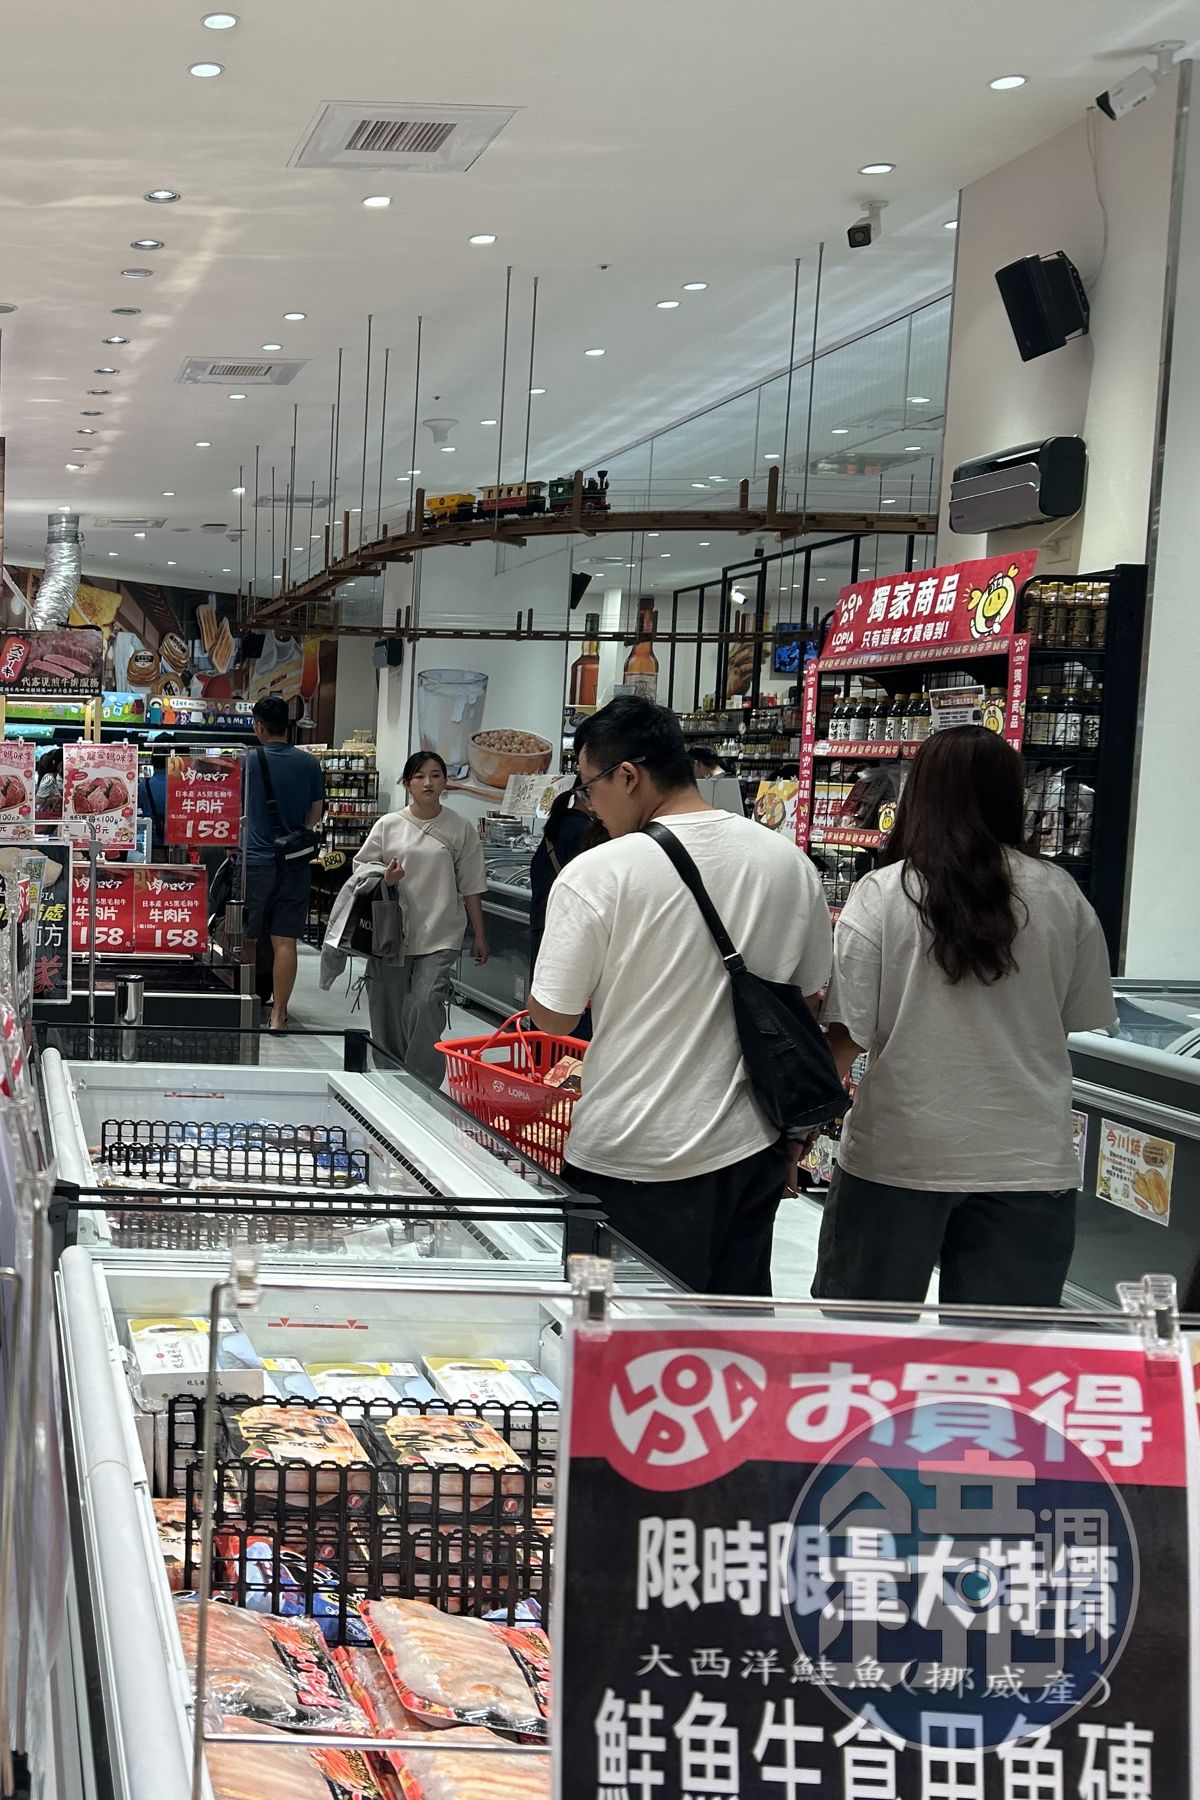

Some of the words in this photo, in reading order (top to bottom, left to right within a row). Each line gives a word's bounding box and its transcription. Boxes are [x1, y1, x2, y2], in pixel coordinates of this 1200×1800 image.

[866, 573, 960, 624] 獨家商品
[831, 631, 854, 646] LOPIA
[1, 642, 25, 679] ステーキ
[180, 766, 229, 786] 肉のロピア
[181, 798, 225, 814] 牛肉片
[185, 820, 231, 839] 158
[74, 874, 122, 892] 肉ロピア
[146, 876, 195, 895] 肉のロピア
[149, 908, 192, 923] 牛肉片
[154, 929, 199, 948] 158
[508, 1087, 531, 1102] LOPIA
[784, 1361, 1154, 1468] お買得
[634, 1515, 1119, 1641] 限時限量大特價
[634, 1642, 1113, 1709] 大西洋鮭魚(挪威產)
